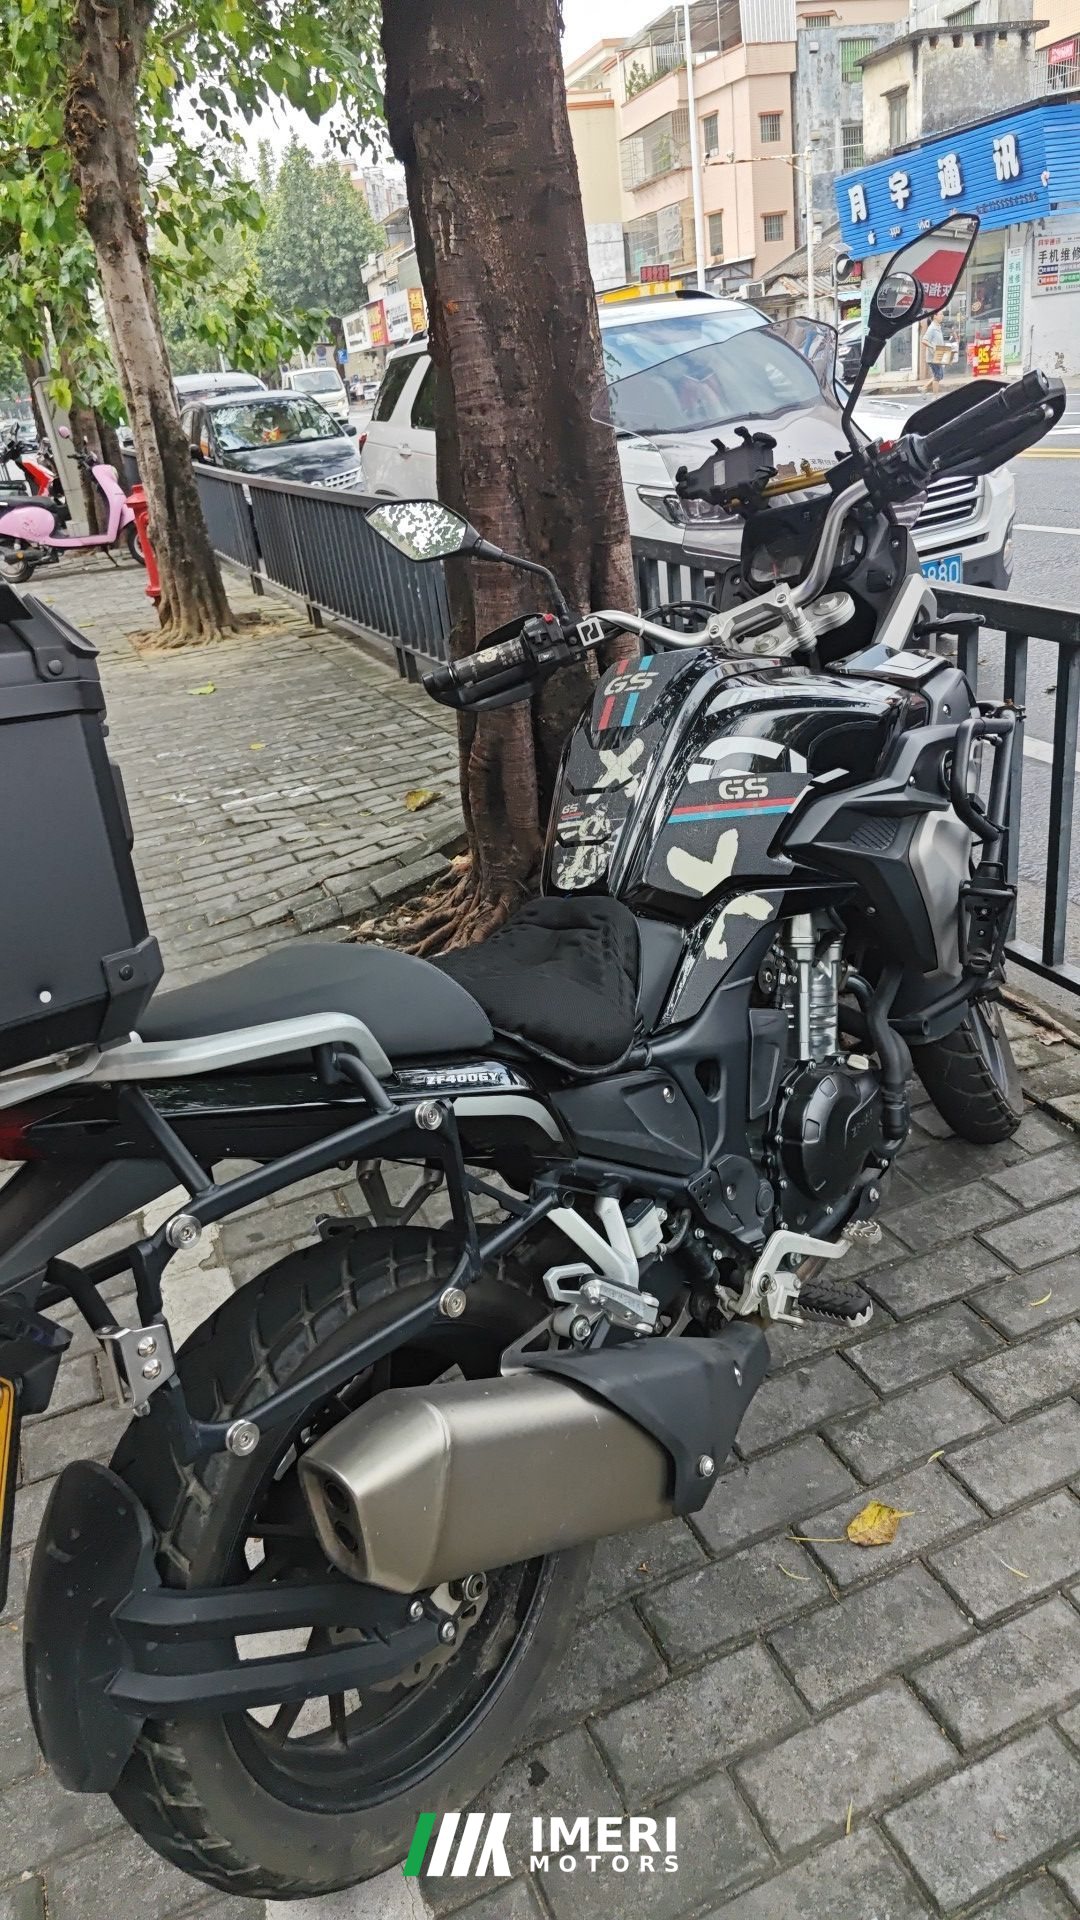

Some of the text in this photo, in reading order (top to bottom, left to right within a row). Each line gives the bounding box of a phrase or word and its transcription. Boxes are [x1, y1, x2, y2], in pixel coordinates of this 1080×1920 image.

[604, 672, 659, 696] GS
[718, 777, 769, 800] GS
[562, 803, 578, 814] GS
[426, 1072, 498, 1085] ZF400GY
